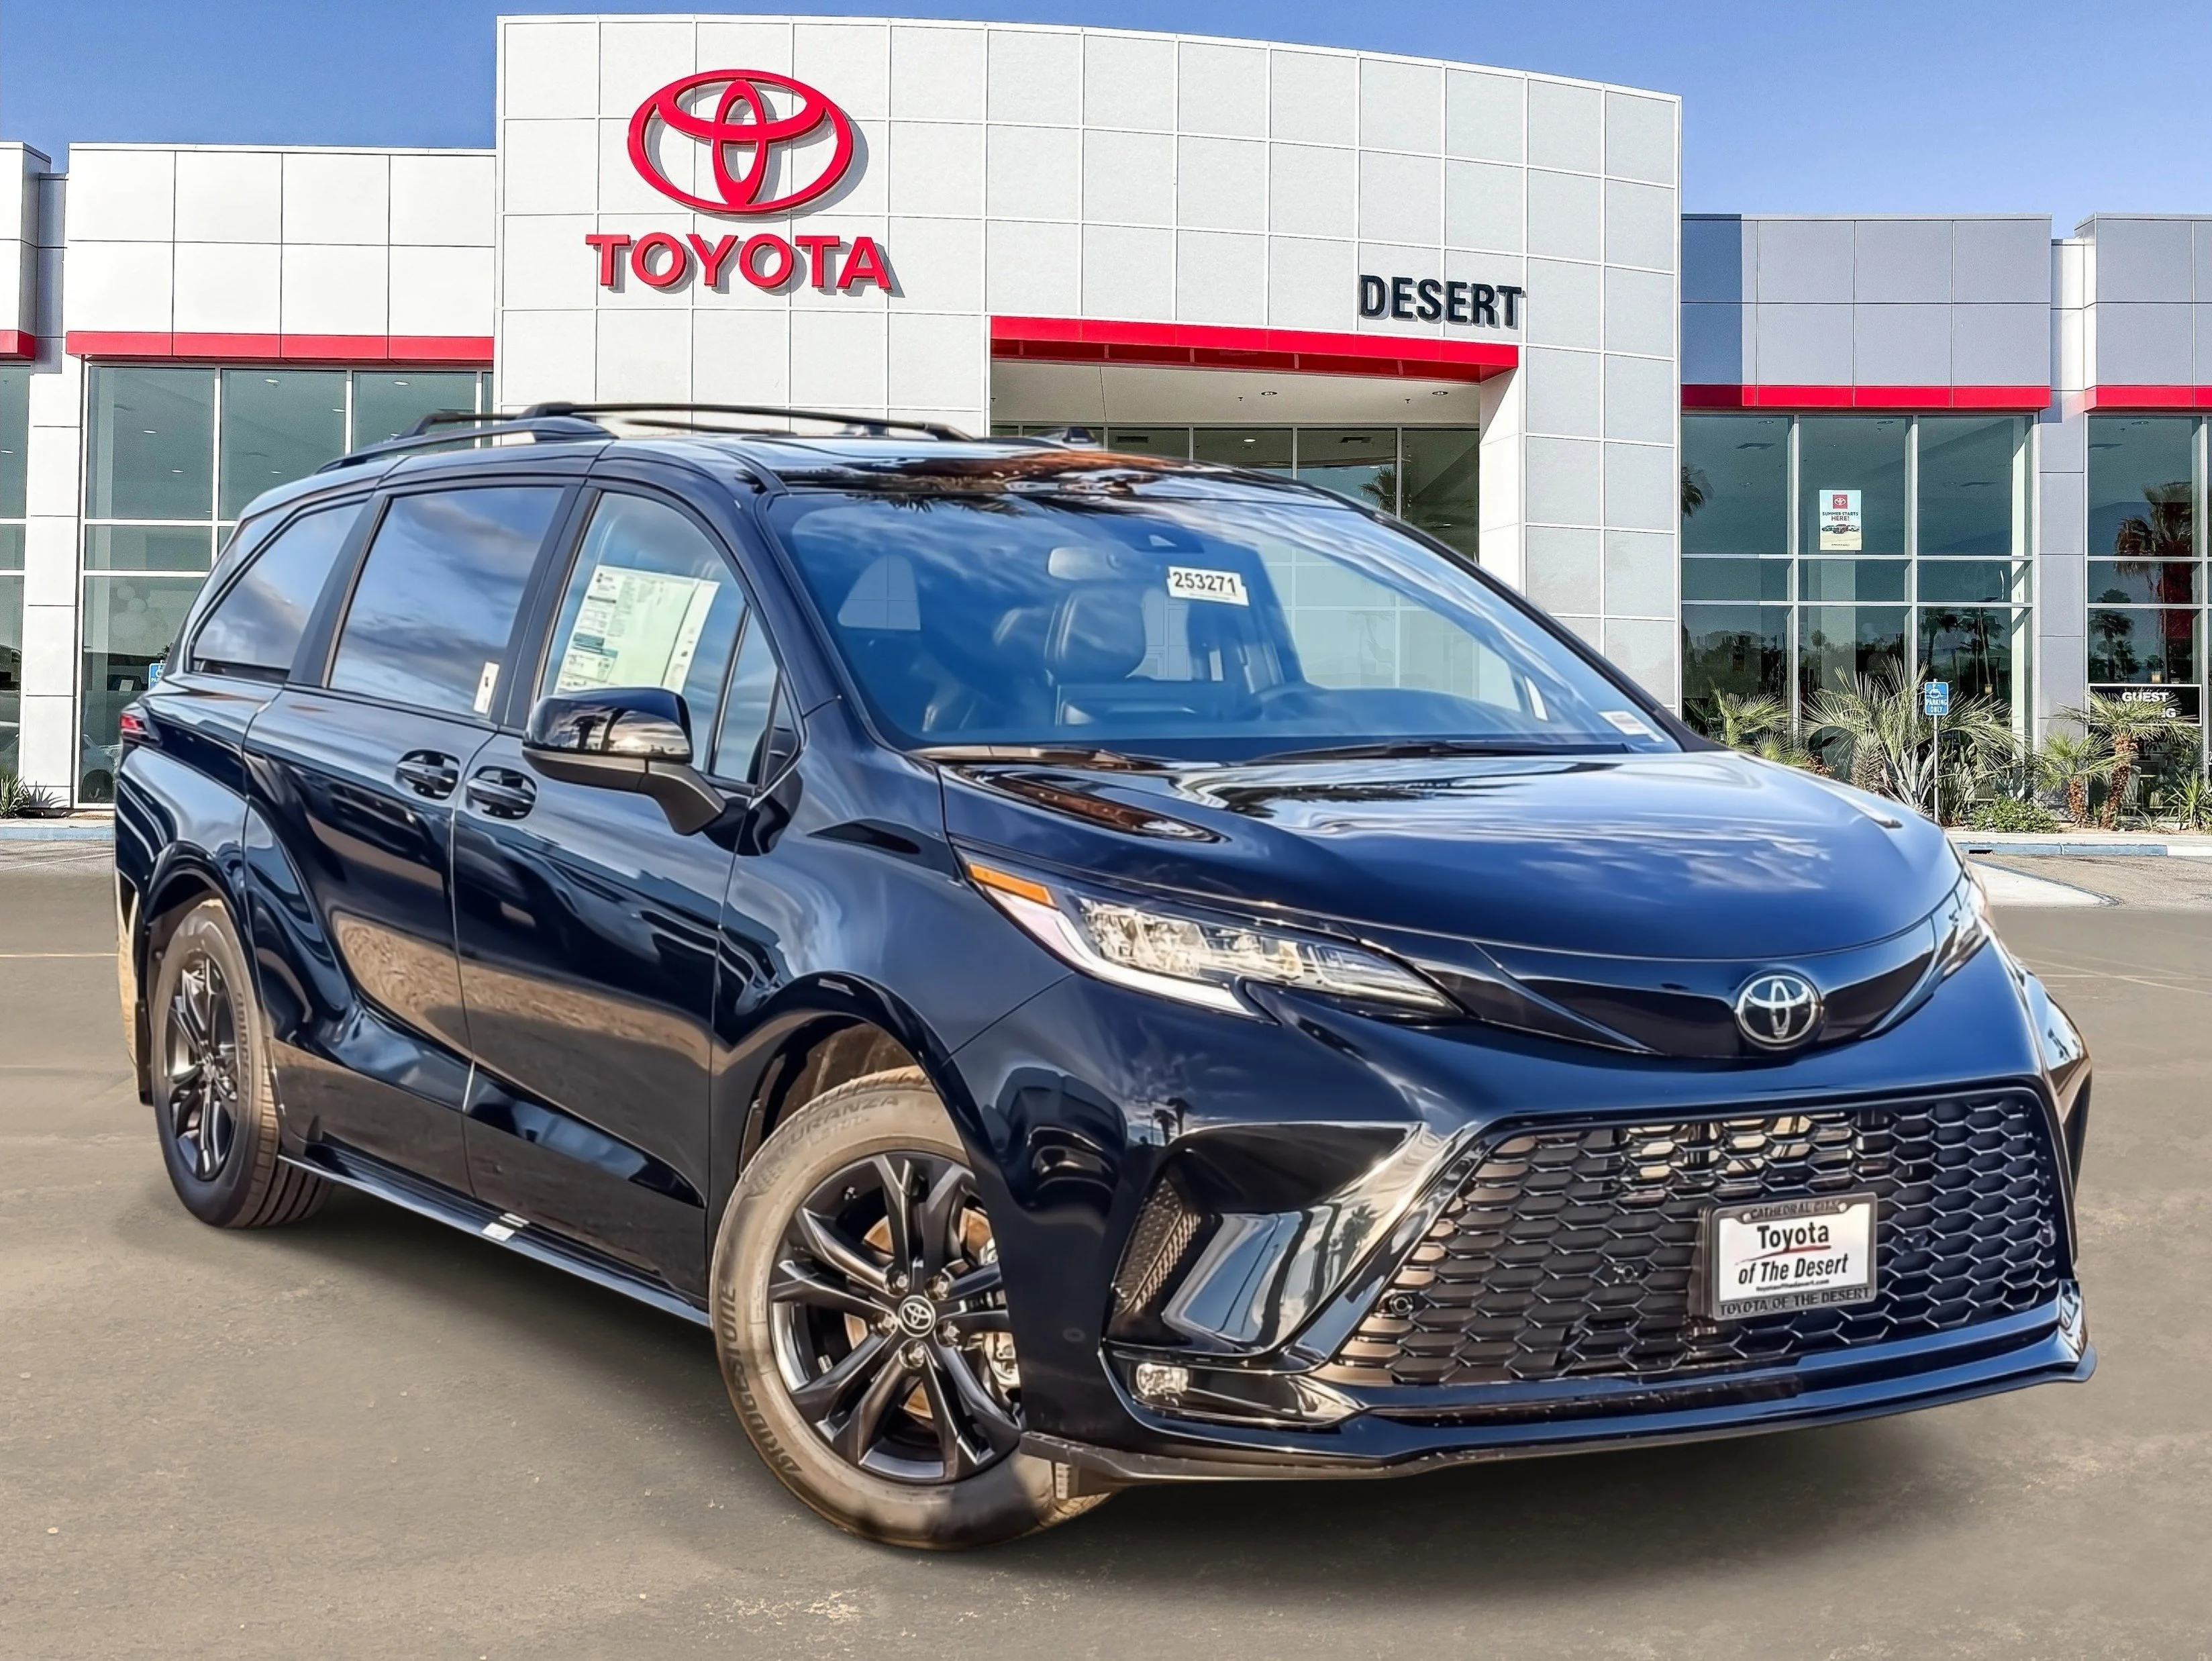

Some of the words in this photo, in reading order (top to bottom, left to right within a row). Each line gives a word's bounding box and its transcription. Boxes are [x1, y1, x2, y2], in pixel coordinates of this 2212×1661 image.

[586, 232, 893, 290] TOYOTA
[1359, 274, 1522, 327] DESERT
[1173, 572, 1237, 595] 253271
[2121, 692, 2169, 703] GUEST
[1757, 1222, 1829, 1251] Toyota
[1738, 1262, 1756, 1285] of
[1761, 1261, 1789, 1282] The
[1795, 1253, 1849, 1278] Desert
[1720, 1298, 1768, 1316] TOYOTA
[1772, 1297, 1788, 1309] OF
[1793, 1293, 1819, 1308] THE
[1821, 1287, 1870, 1304] DESERT
